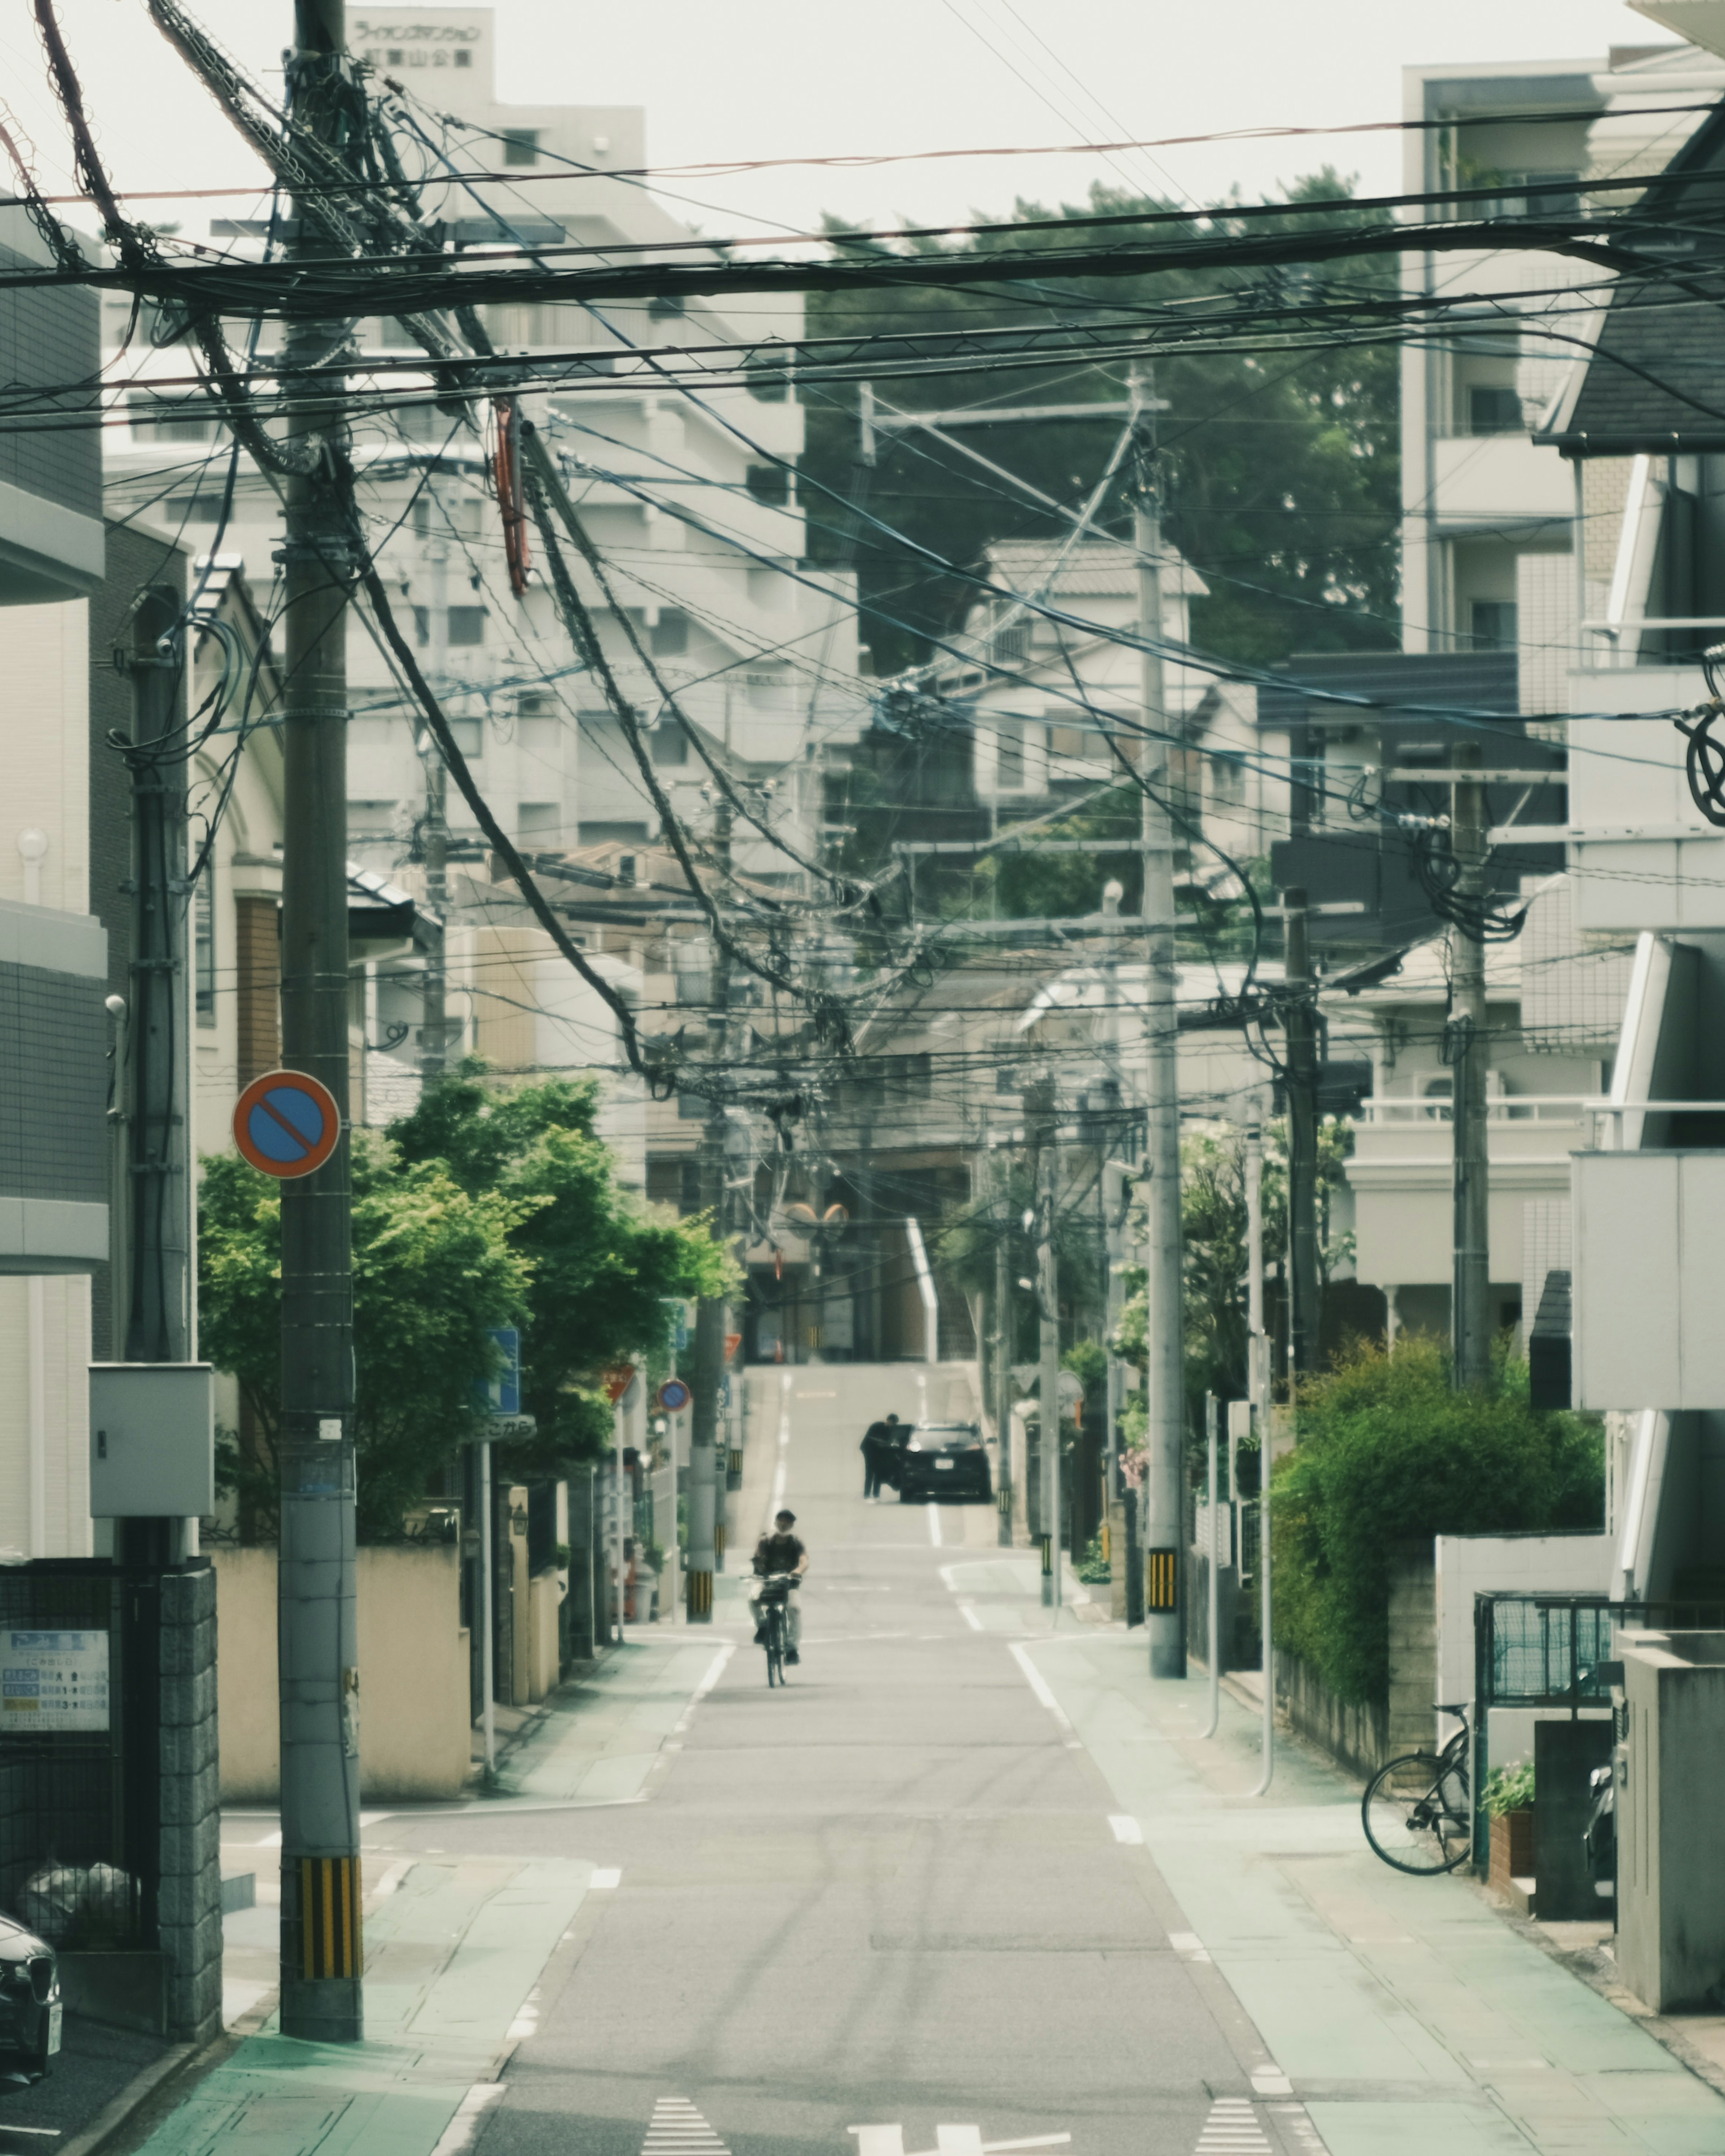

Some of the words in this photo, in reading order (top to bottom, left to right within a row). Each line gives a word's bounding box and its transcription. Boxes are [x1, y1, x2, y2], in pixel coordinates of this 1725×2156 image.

[354, 21, 480, 42] ライオンズマンション
[474, 1421, 531, 1436] ここから
